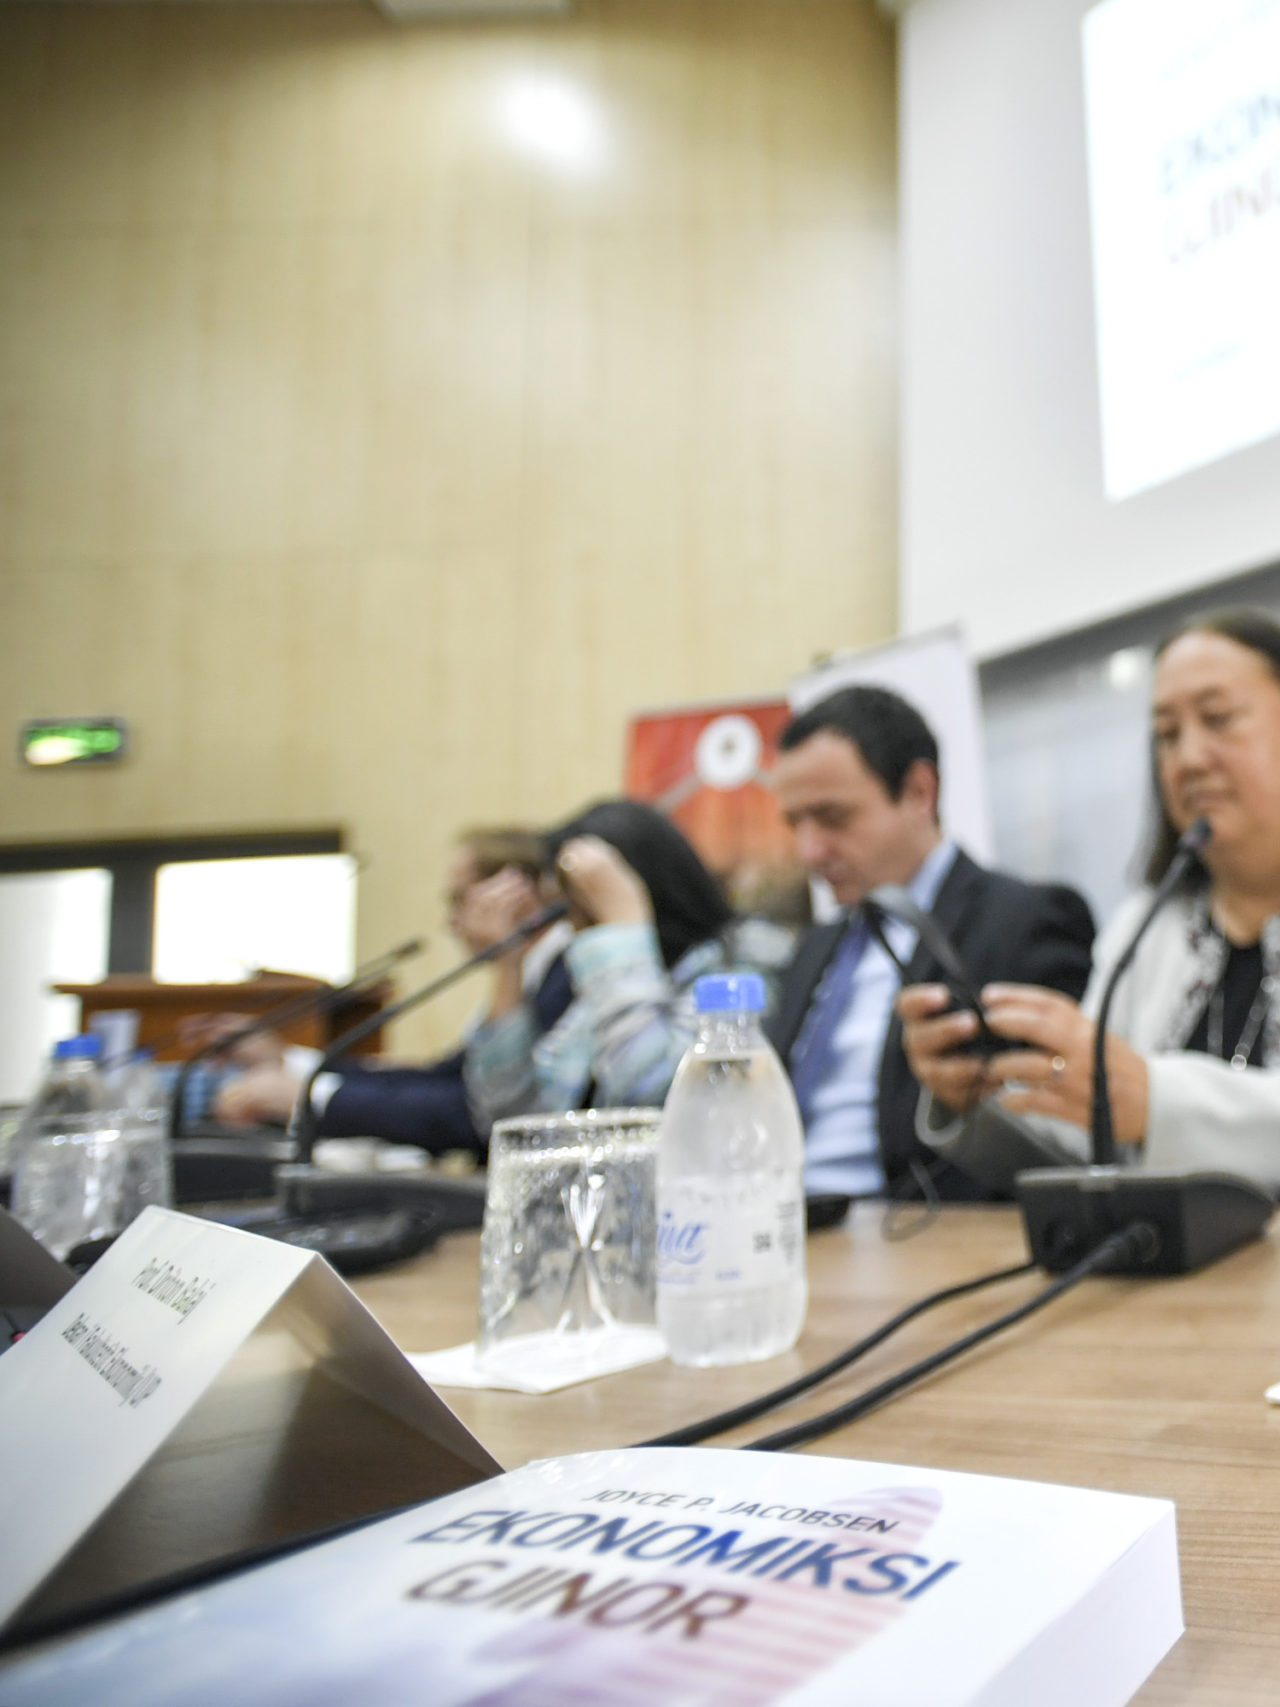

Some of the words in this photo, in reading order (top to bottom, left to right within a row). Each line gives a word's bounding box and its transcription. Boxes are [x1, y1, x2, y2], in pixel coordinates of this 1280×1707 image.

[582, 1488, 686, 1509] JOYCE
[684, 1495, 714, 1513] P.
[722, 1501, 899, 1534] JACOBSEN
[406, 1509, 962, 1602] EKONOMIKSI
[404, 1559, 751, 1640] GJINOR
